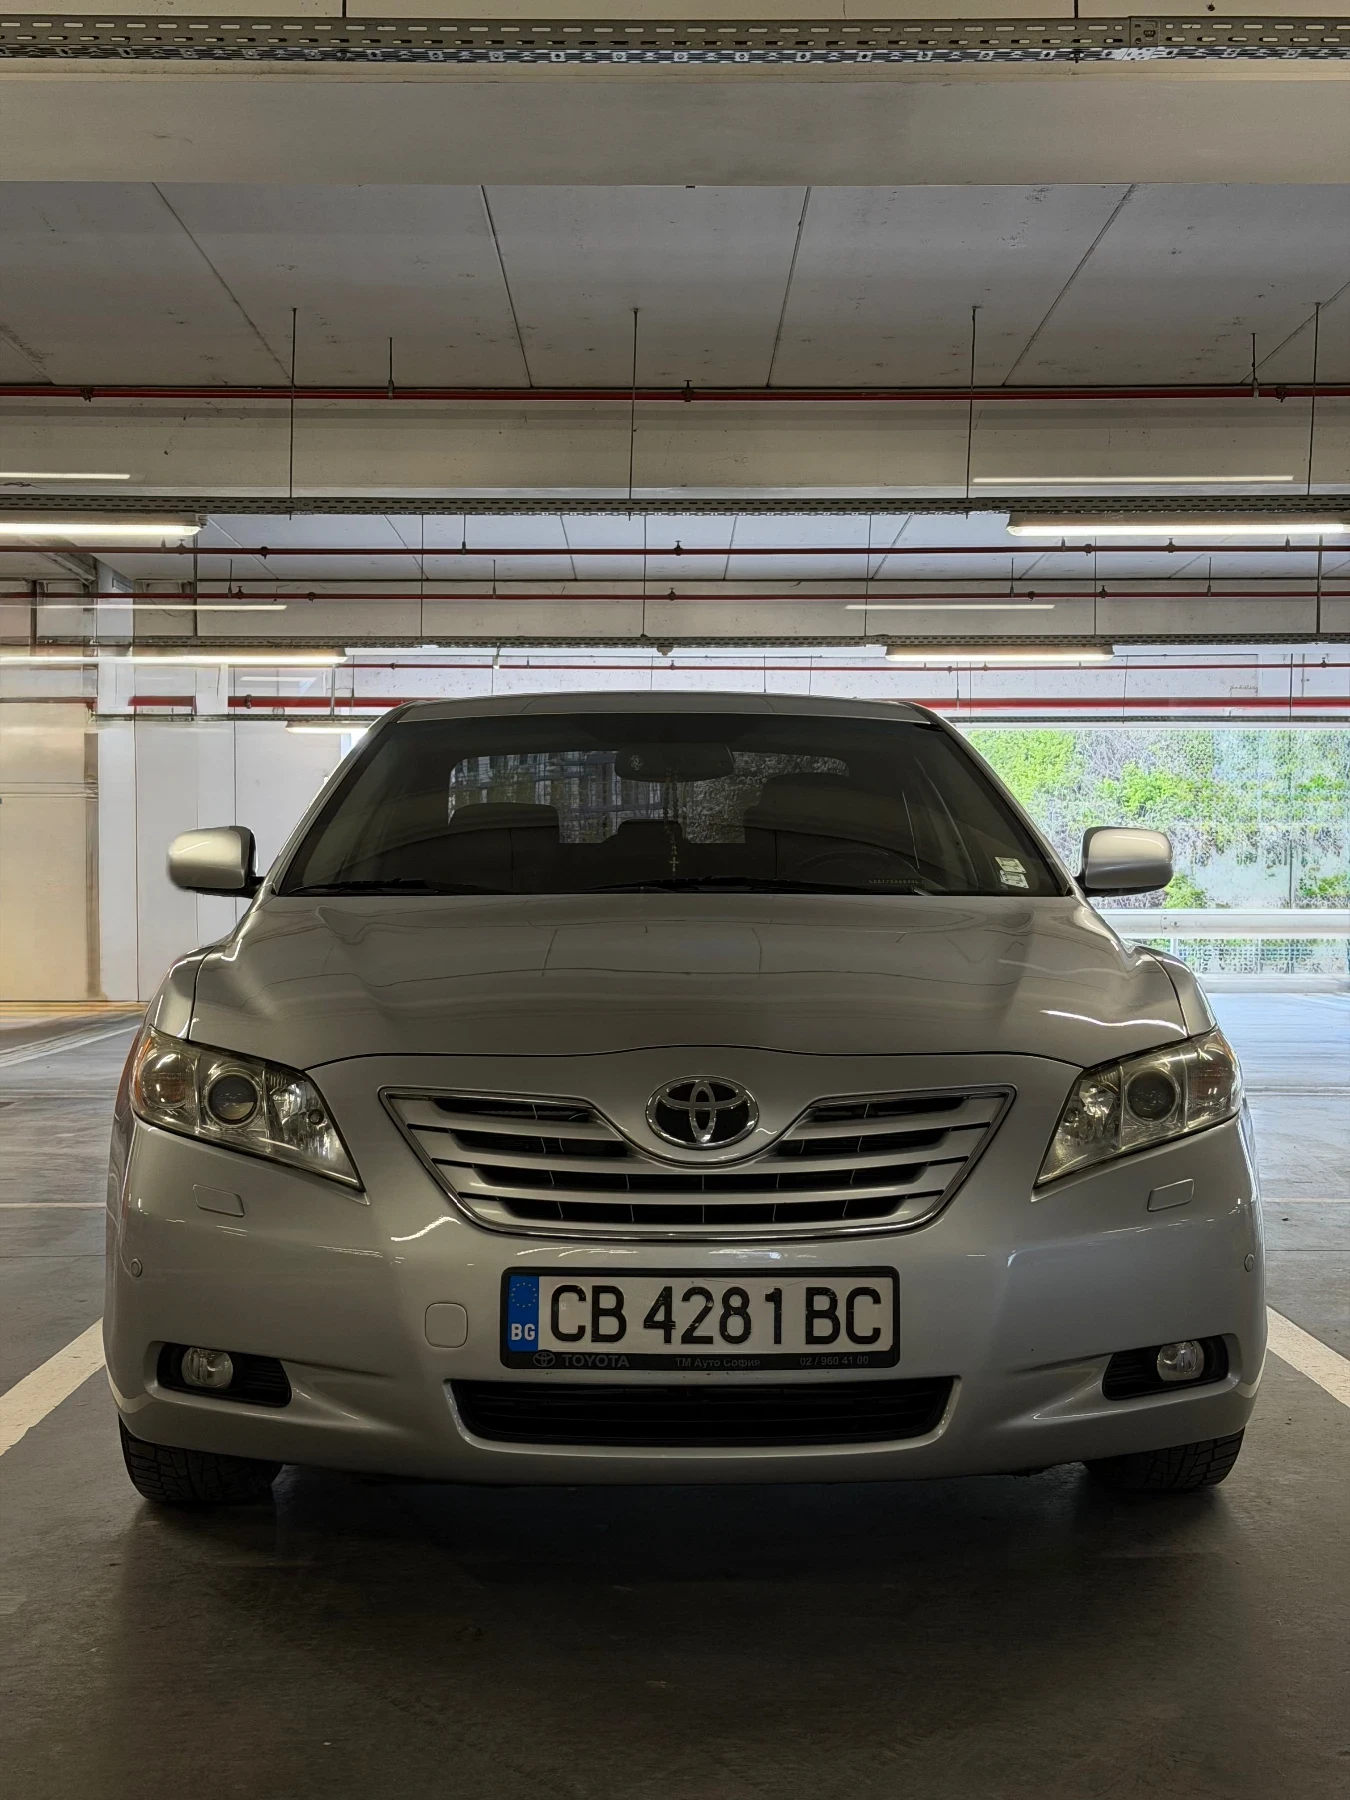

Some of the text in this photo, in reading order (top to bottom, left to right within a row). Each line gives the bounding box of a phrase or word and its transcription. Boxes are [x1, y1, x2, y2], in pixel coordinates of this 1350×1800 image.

[550, 1284, 882, 1345] CB 4281 BC
[511, 1323, 536, 1341] BG
[562, 1354, 630, 1368] TOYOTA
[723, 1357, 761, 1369] София
[800, 1357, 812, 1366] 02
[821, 1356, 839, 1366] 960
[841, 1356, 853, 1365] 41
[857, 1355, 869, 1364] 00
